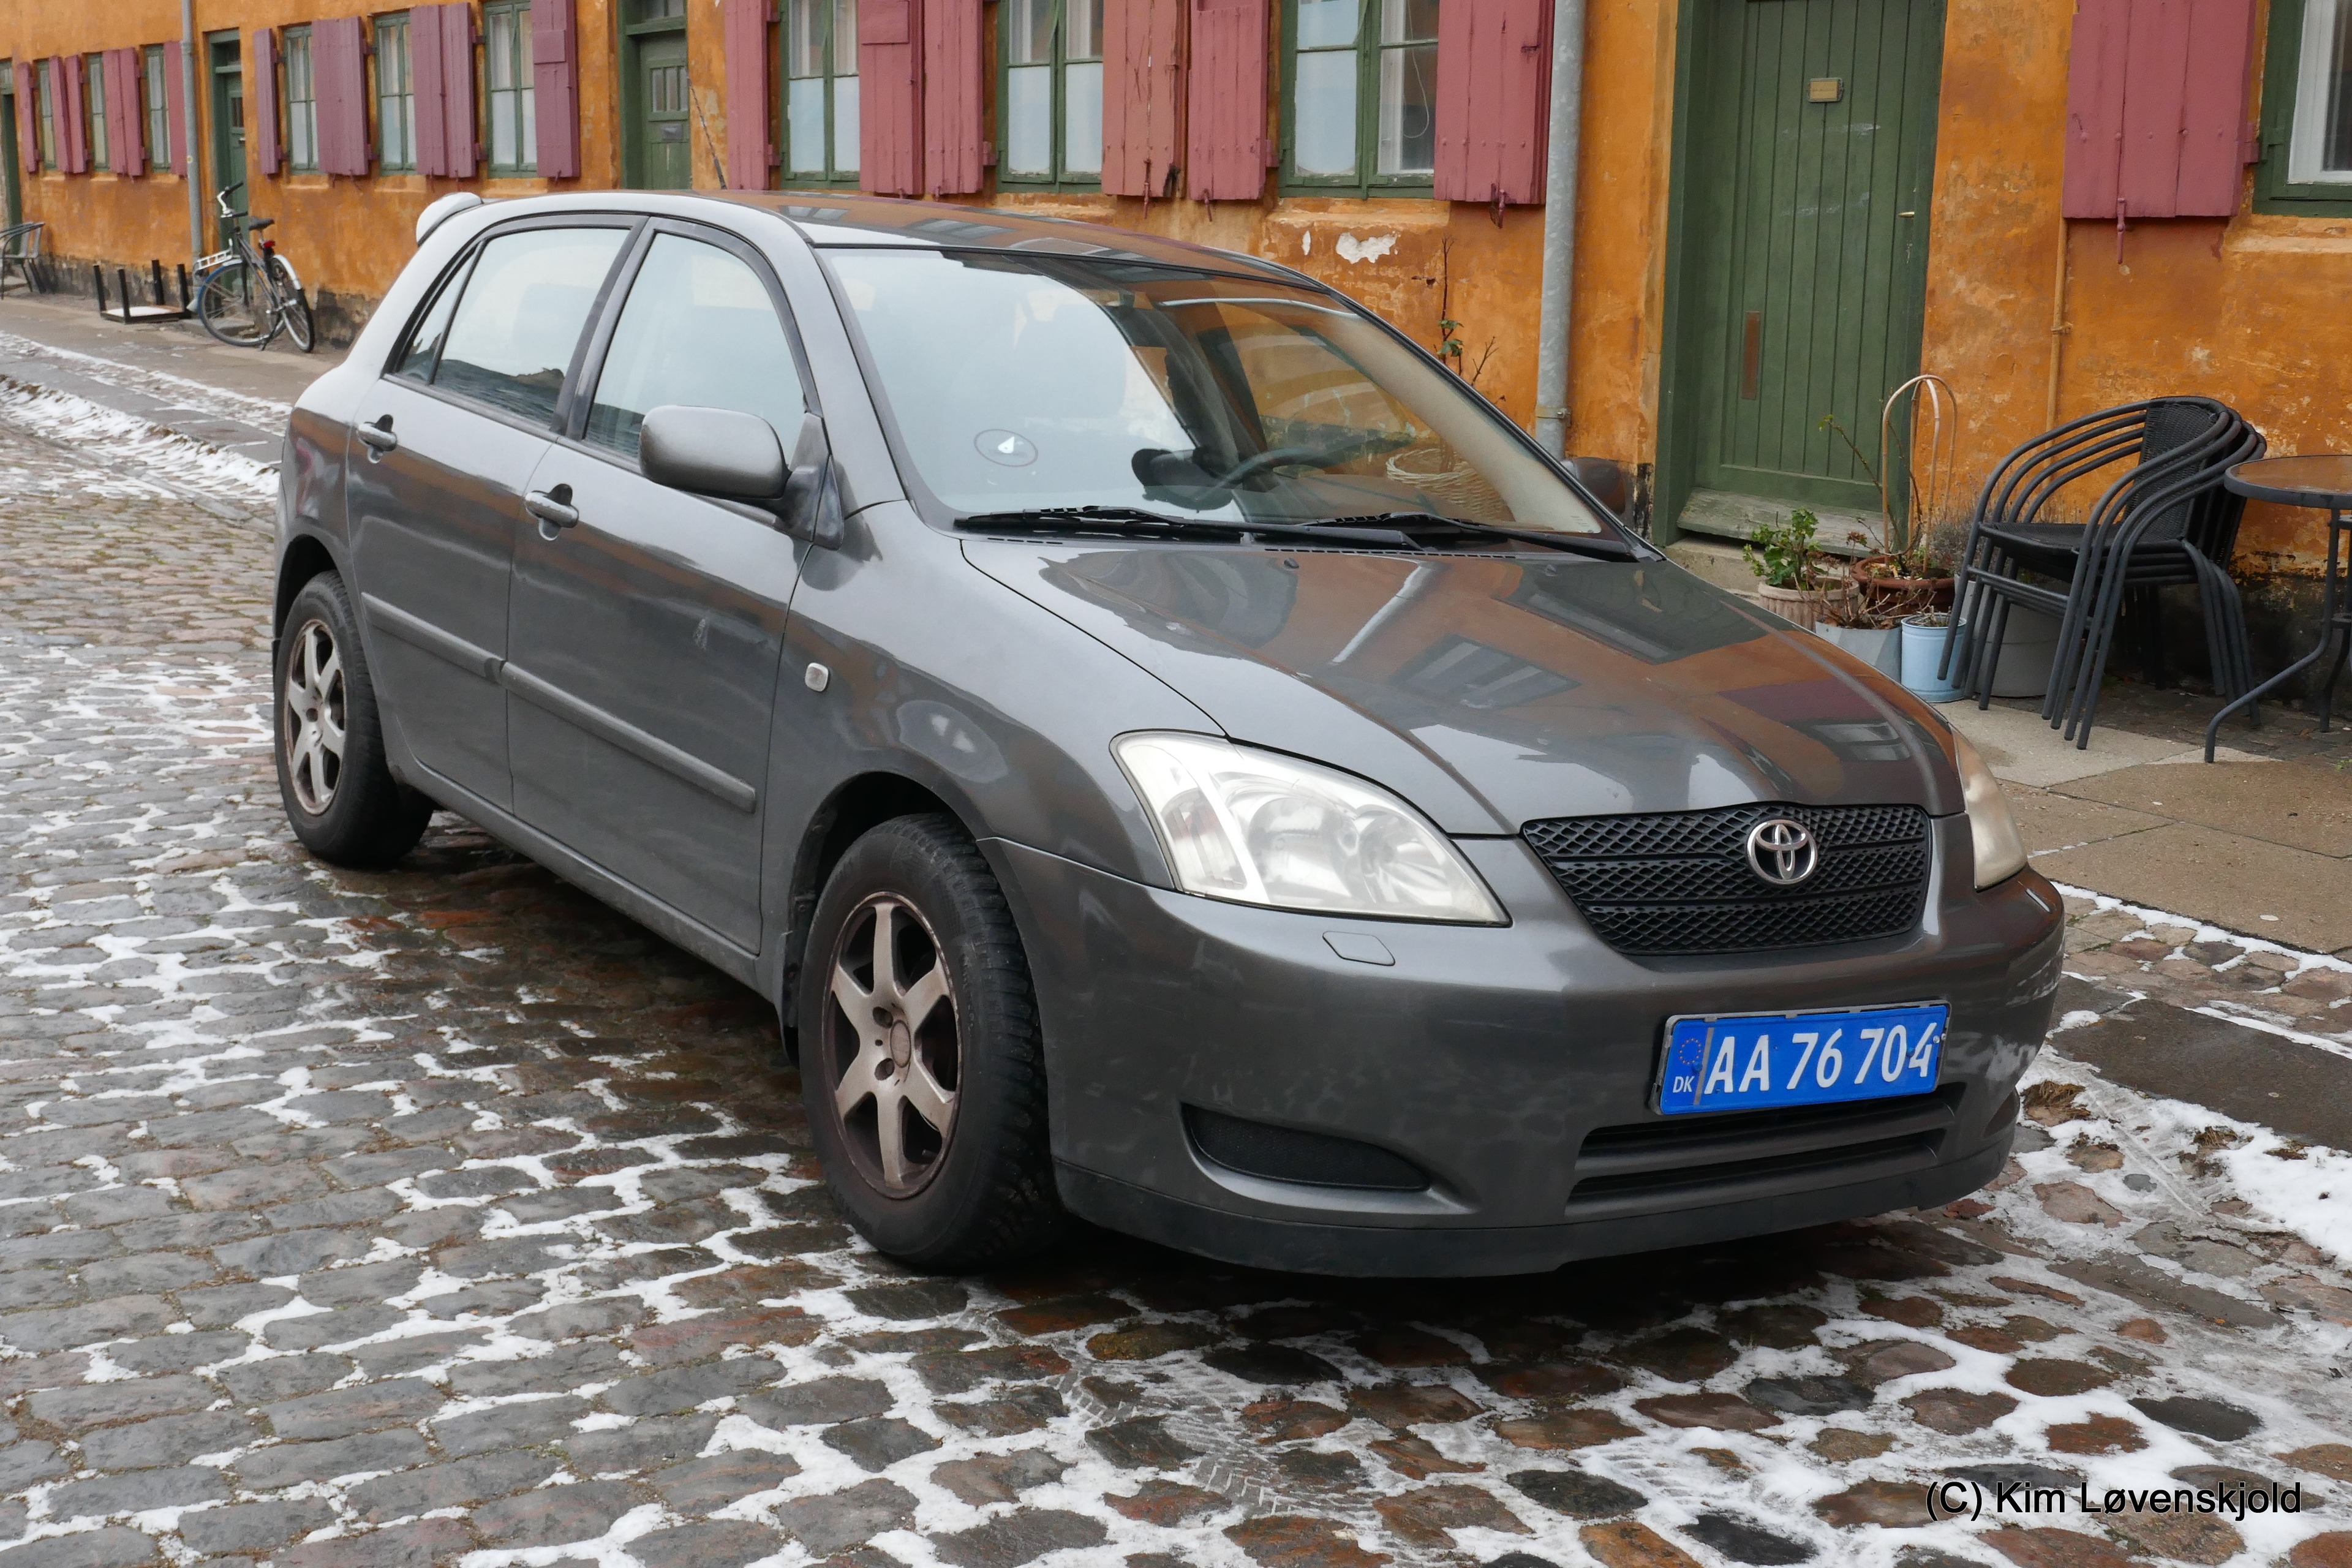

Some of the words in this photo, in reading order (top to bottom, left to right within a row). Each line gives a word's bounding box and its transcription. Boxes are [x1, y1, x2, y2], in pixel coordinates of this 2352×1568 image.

[1704, 1035, 1770, 1095] AA
[1786, 1028, 1843, 1090] 76
[1854, 1022, 1937, 1085] 704
[1673, 1075, 1694, 1093] DK
